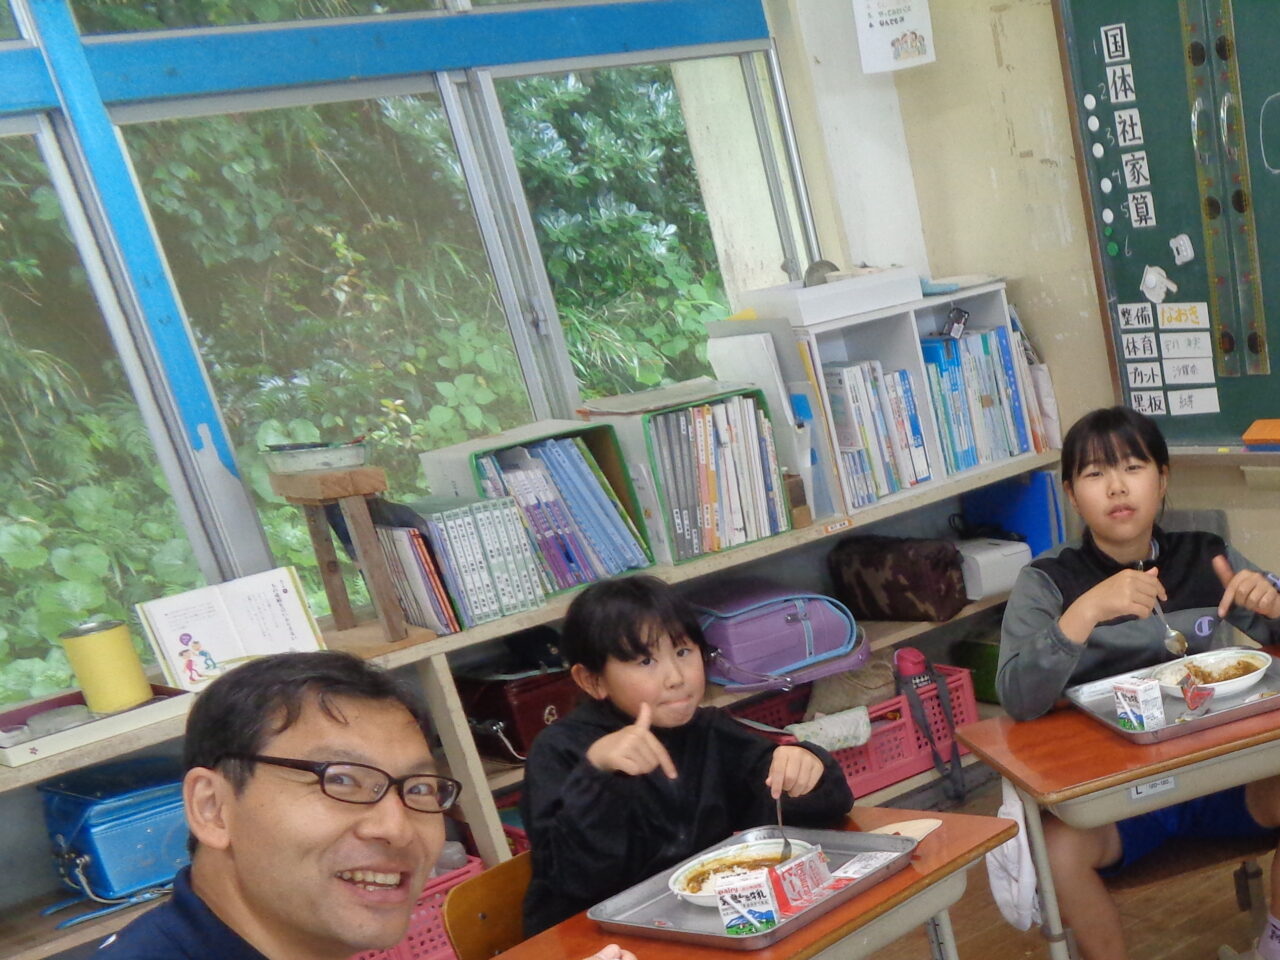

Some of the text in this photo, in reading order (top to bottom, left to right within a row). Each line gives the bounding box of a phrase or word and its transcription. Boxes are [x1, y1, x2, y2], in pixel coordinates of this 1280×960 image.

[1105, 28, 1127, 60] 国
[1109, 67, 1135, 101] 体
[1117, 113, 1143, 145] 社
[1124, 154, 1150, 187] 家
[1131, 192, 1154, 227] 算
[1120, 306, 1151, 327] 整備
[1125, 334, 1155, 357] 体育
[1129, 365, 1160, 385] プリント
[1133, 393, 1166, 414] 黒板
[1135, 785, 1143, 796] L
